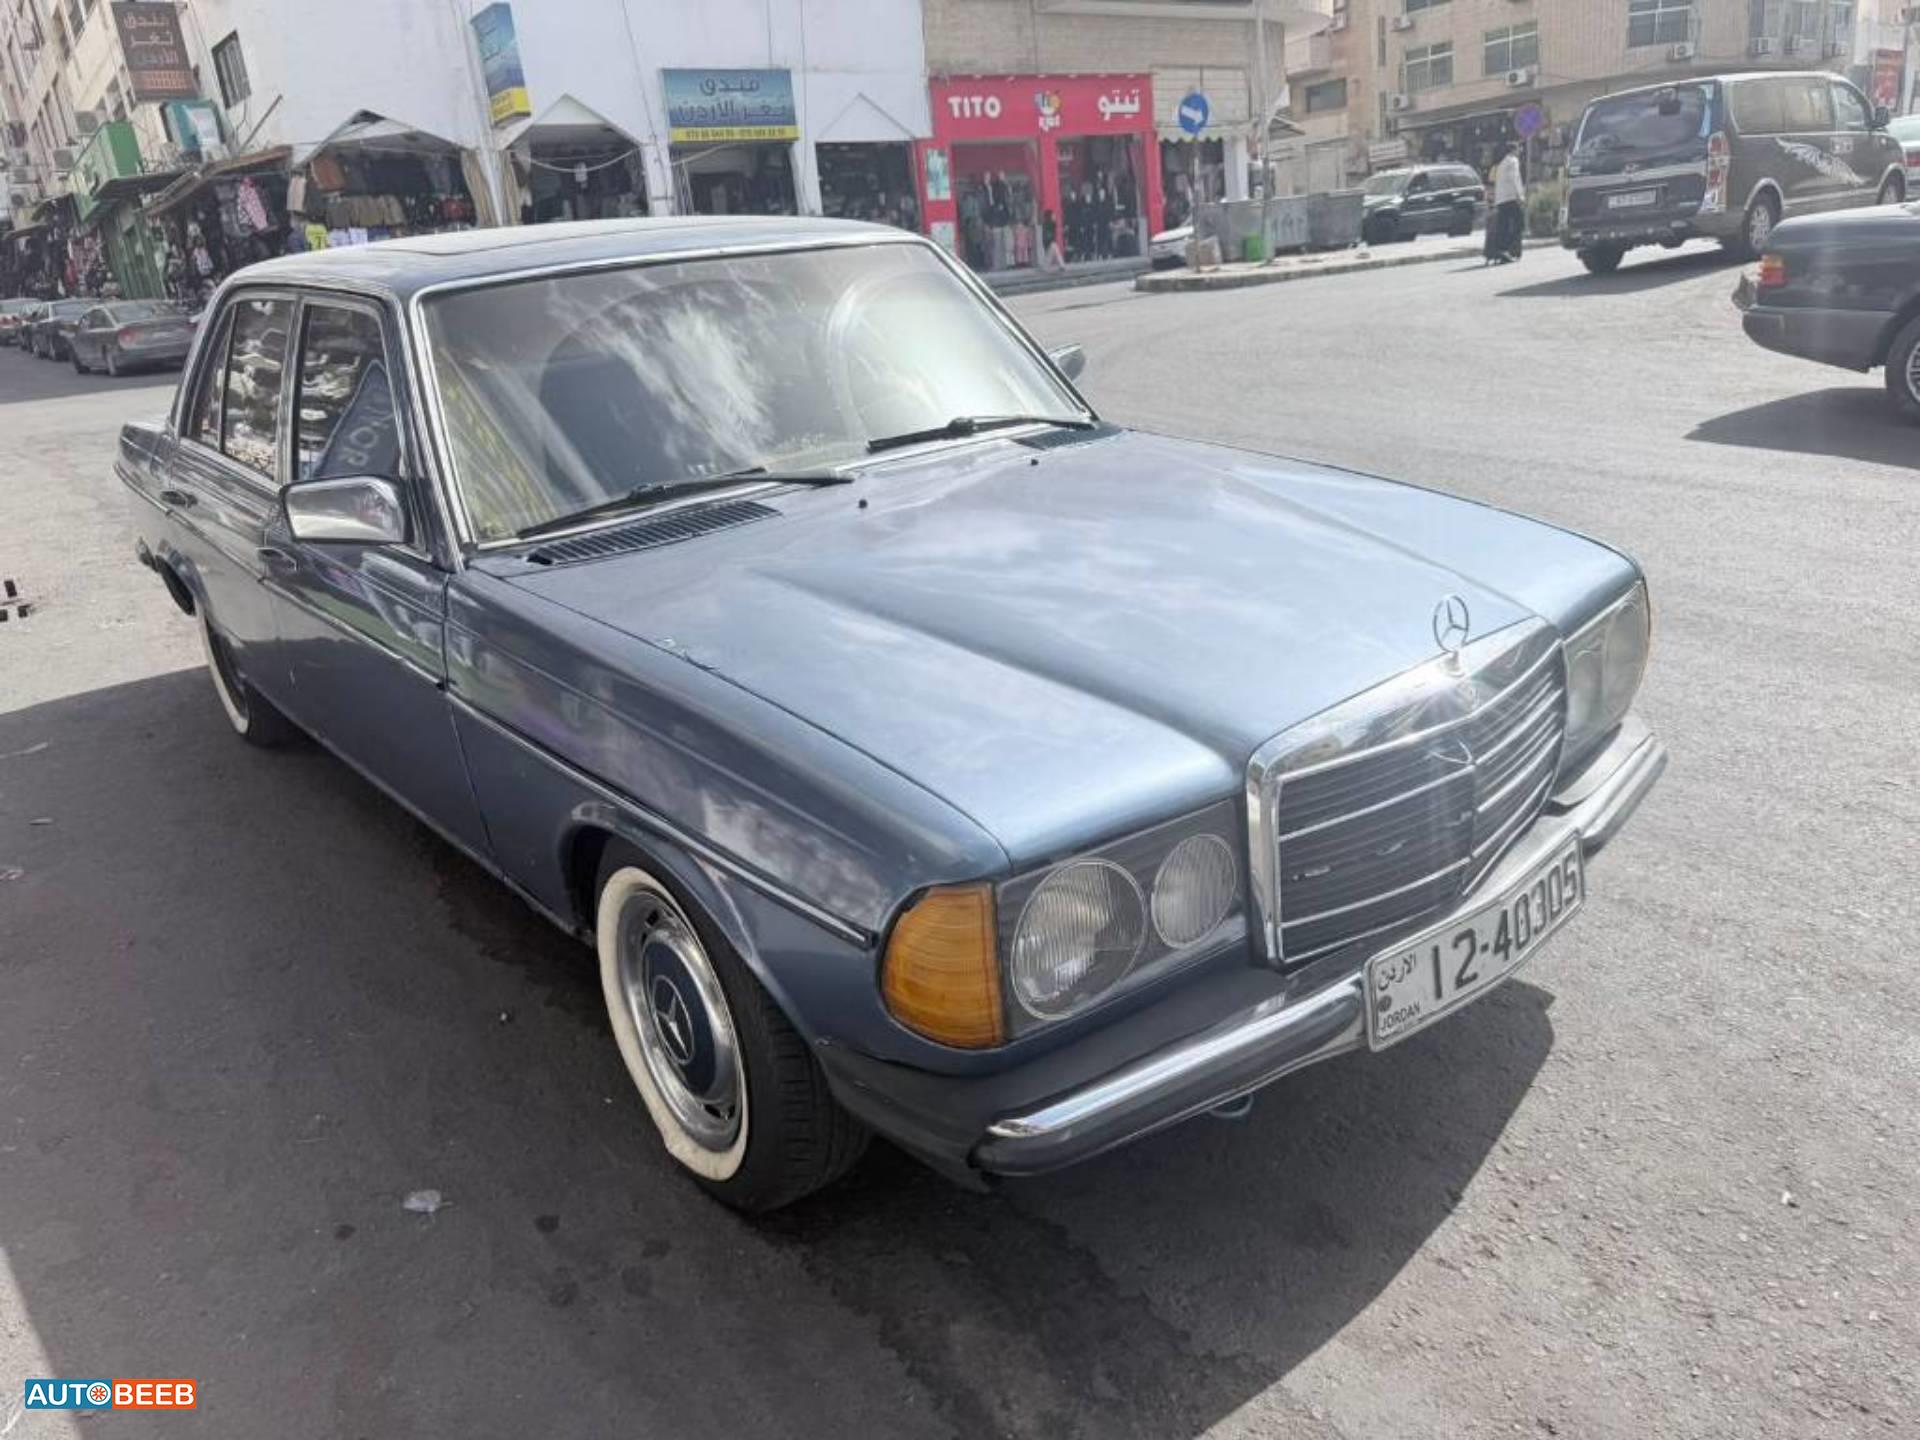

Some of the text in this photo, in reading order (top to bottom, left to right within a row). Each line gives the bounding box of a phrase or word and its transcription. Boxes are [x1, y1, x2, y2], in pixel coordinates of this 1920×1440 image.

[948, 96, 1001, 119] TITO
[1098, 89, 1141, 121] تيتو
[1431, 851, 1577, 999] 12-40305
[1379, 1000, 1421, 1031] JORDAN
